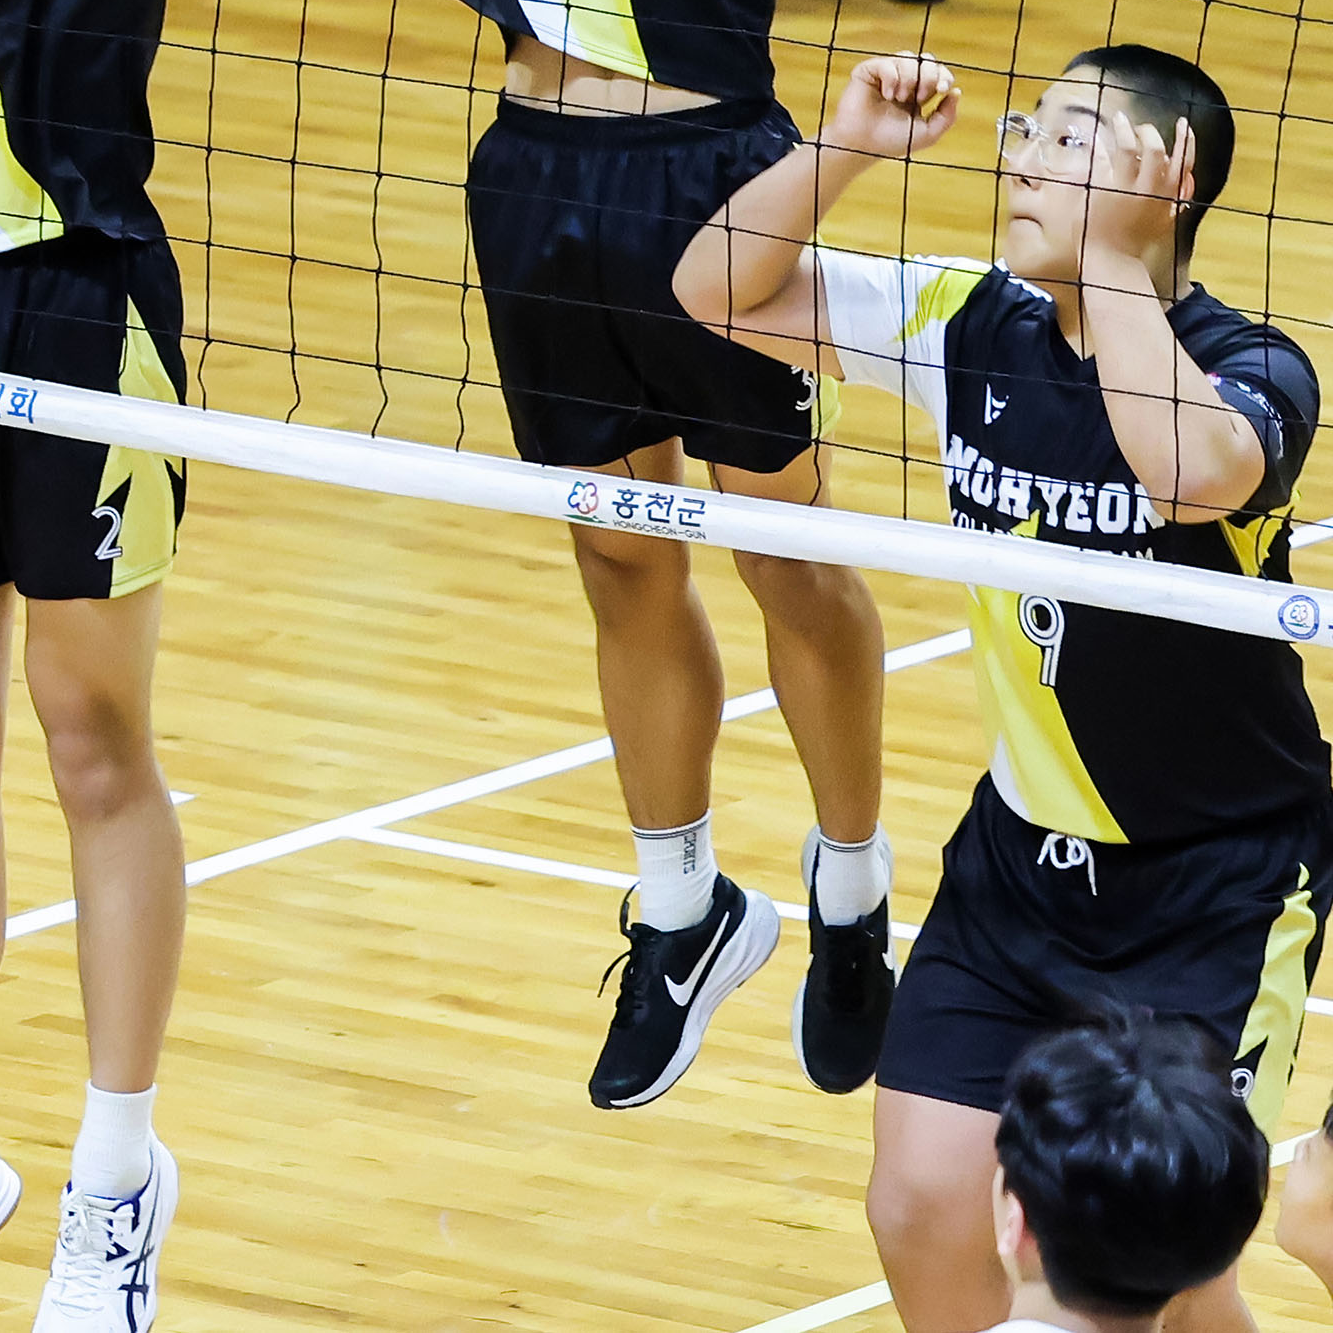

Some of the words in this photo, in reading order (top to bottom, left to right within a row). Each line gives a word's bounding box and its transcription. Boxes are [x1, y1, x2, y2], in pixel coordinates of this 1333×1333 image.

[612, 489, 707, 528] 홍천군
[613, 518, 708, 541] HONGCHEON-GUN
[91, 506, 123, 560] 2
[1017, 593, 1066, 687] 9
